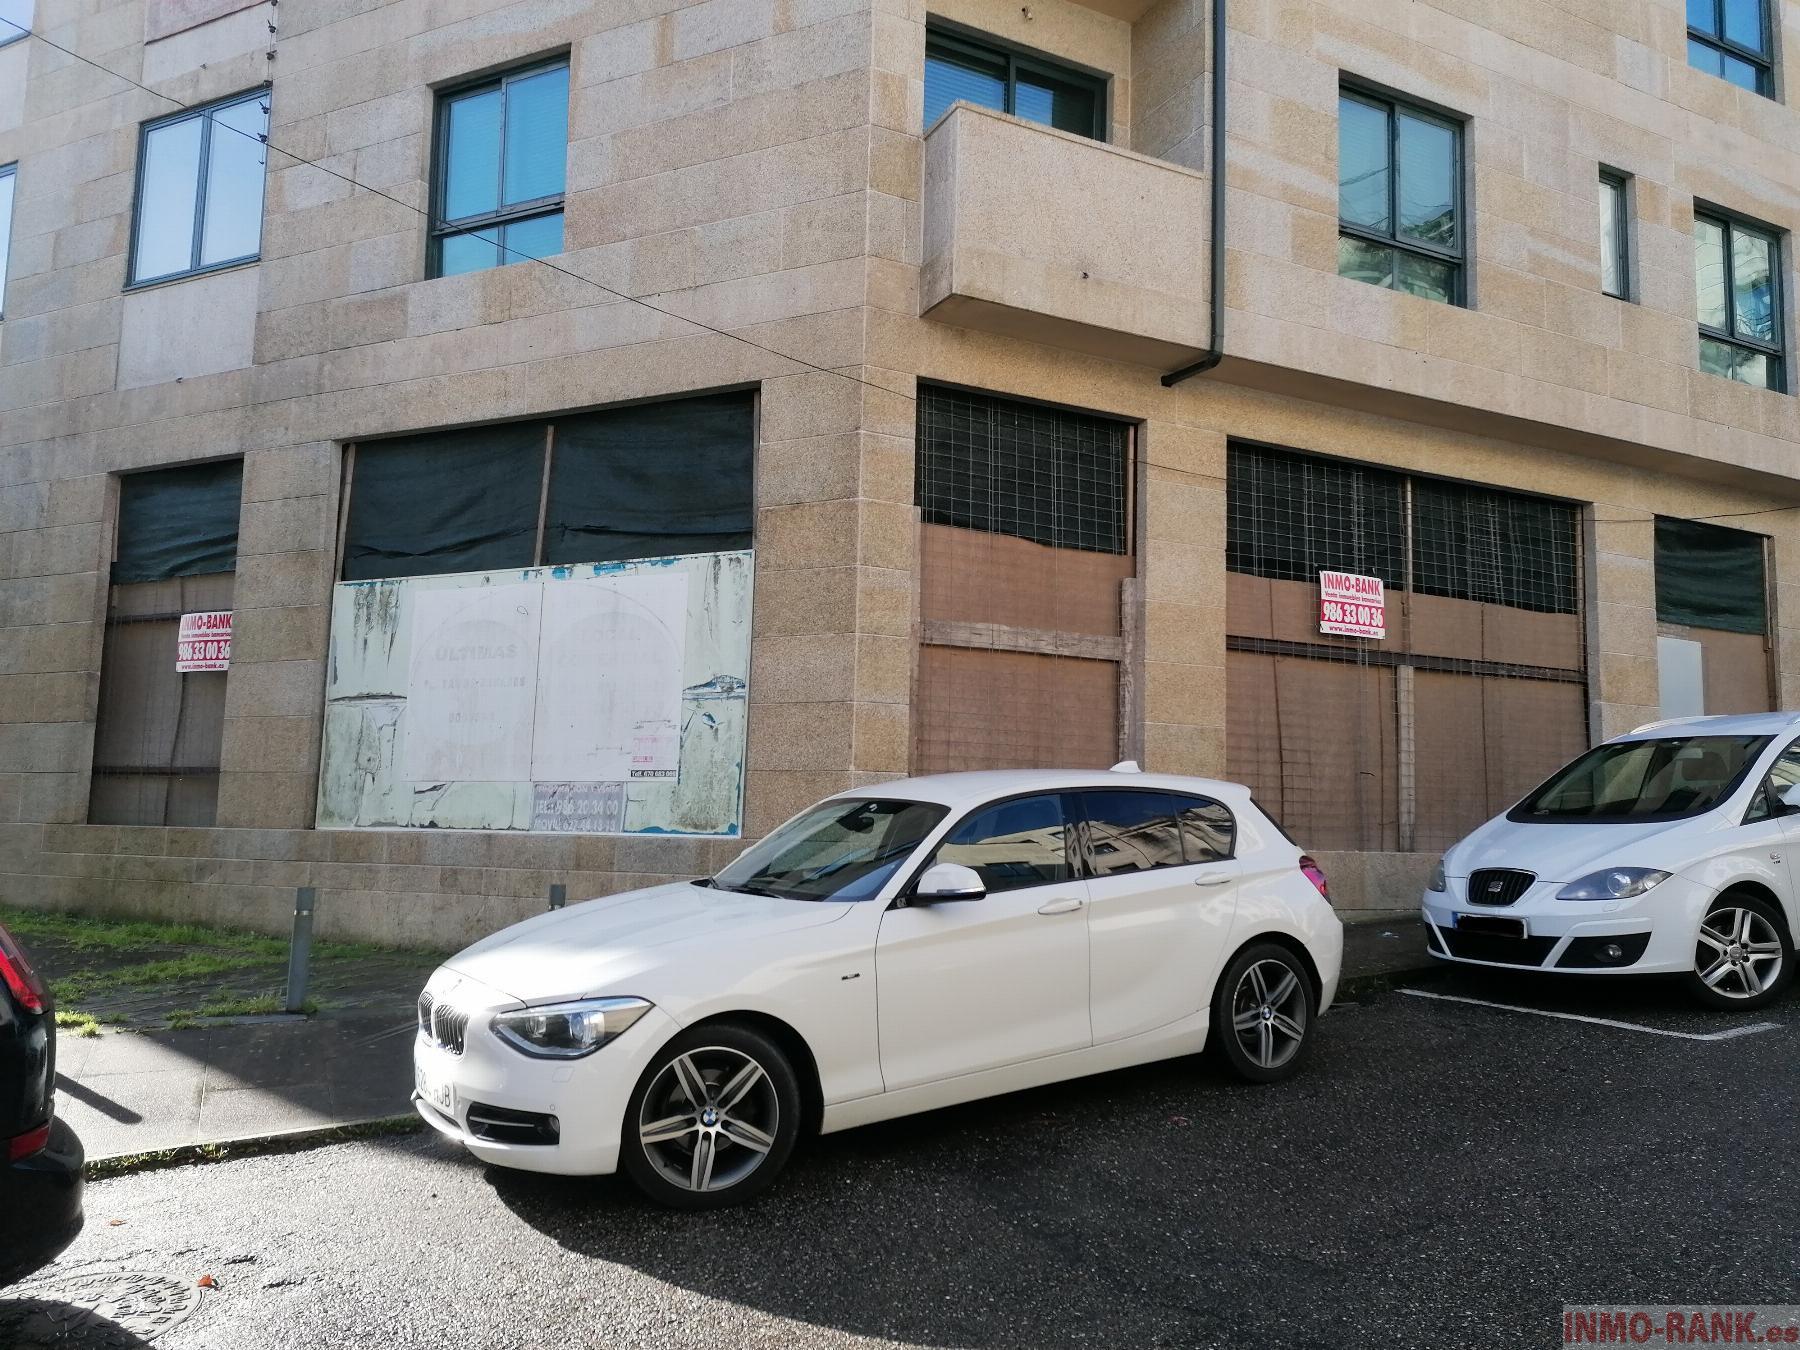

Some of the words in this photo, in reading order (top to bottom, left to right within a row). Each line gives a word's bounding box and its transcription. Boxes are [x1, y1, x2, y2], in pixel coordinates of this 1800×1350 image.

[1323, 573, 1381, 597] INMO-BANK
[181, 614, 232, 631] INMO-BANK
[1323, 601, 1343, 622] 986
[1343, 604, 1357, 624] 33
[1358, 606, 1371, 626] 00
[1371, 608, 1384, 628] 36
[193, 642, 205, 660] 33
[205, 641, 218, 660] 00
[218, 641, 231, 660] 36
[578, 799, 589, 815] 20
[591, 799, 604, 815] 34
